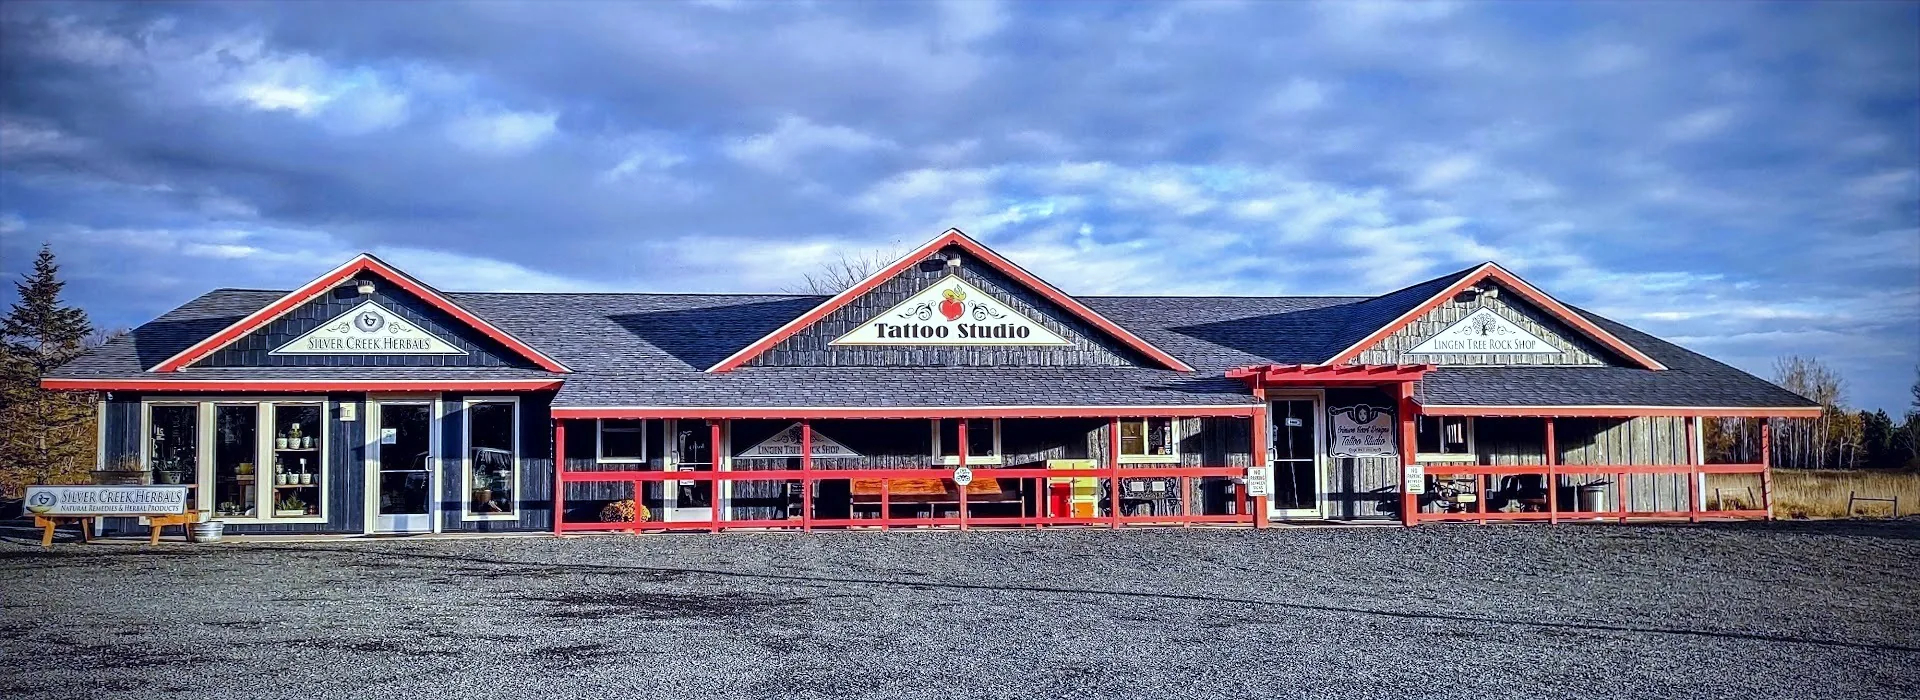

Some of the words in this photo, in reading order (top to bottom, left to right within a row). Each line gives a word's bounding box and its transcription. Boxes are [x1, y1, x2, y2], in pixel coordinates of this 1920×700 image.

[874, 323, 949, 339] Tattoo
[958, 323, 1030, 339] Studio
[307, 337, 344, 350] SILVER
[346, 337, 381, 350] CREEK
[384, 337, 431, 350] HERBALS
[1434, 339, 1465, 350] LINGEN
[1467, 339, 1487, 350] TREE
[1489, 339, 1513, 350] ROCK
[1514, 339, 1536, 350] SHOP
[1342, 435, 1361, 446] Tattoo
[1365, 435, 1385, 446] Studio
[822, 445, 840, 454] SHOP
[61, 490, 97, 503] SILVER
[99, 490, 134, 503] CREEK
[135, 489, 182, 503] HERBALS
